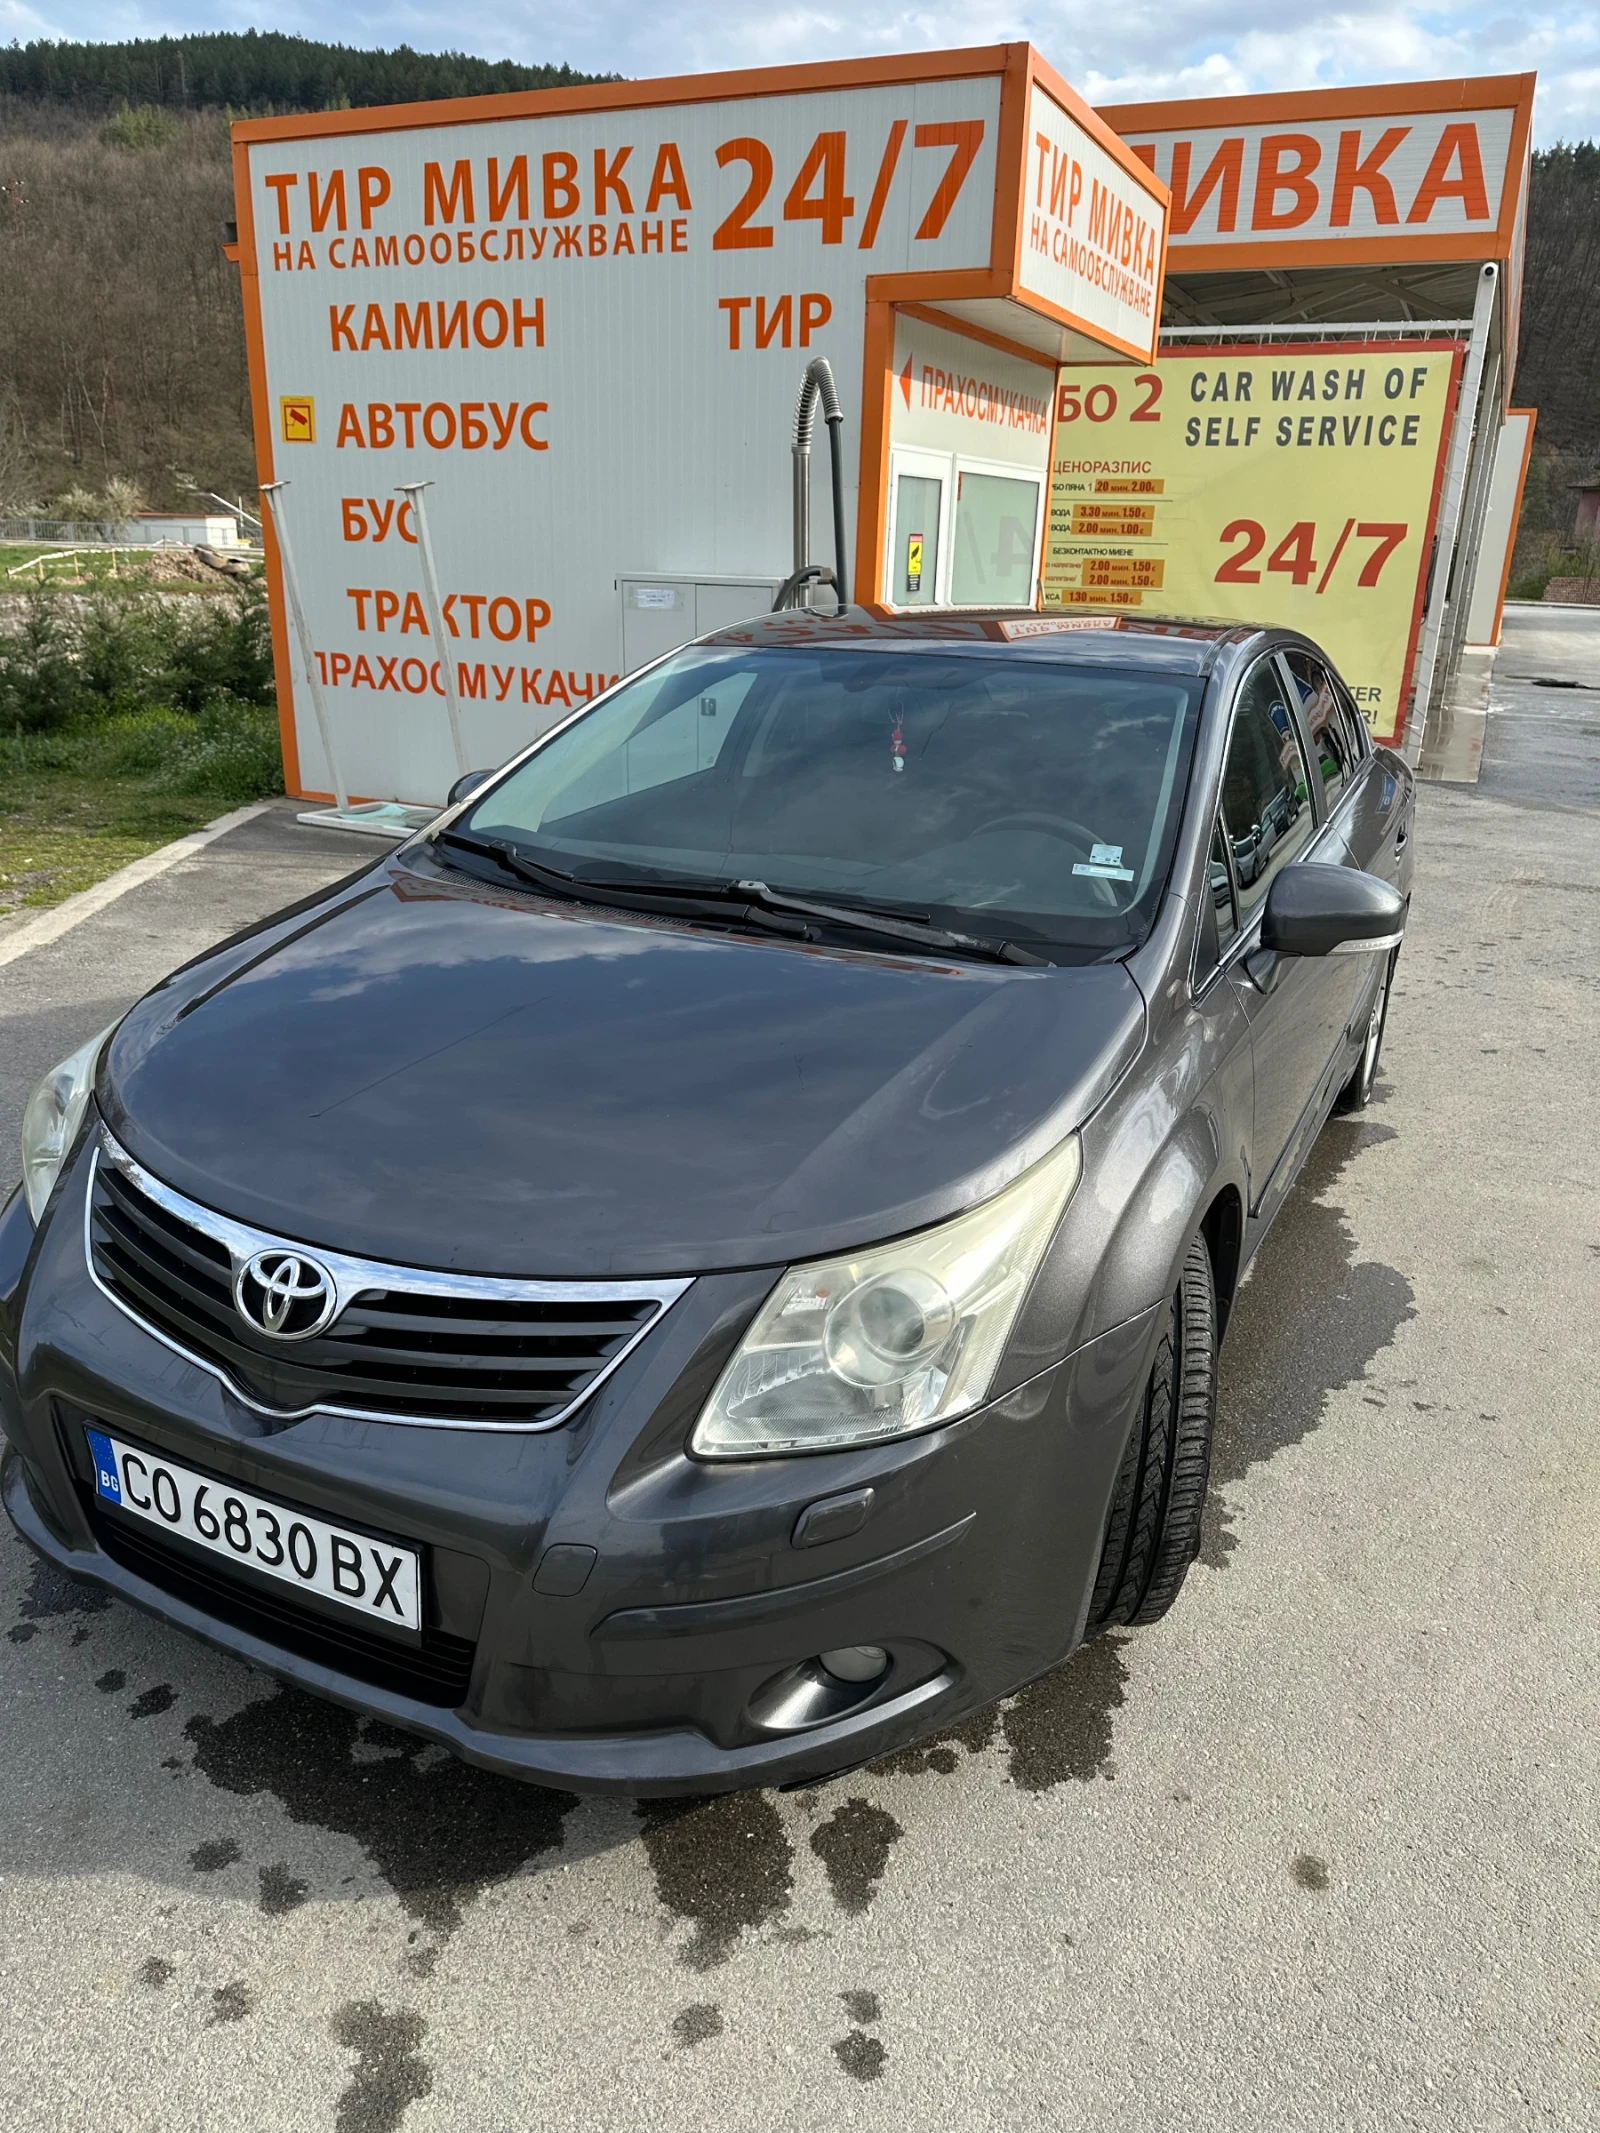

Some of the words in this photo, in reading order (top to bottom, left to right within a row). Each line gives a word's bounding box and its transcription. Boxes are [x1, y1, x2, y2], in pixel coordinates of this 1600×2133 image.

[265, 166, 391, 234] ТИР
[424, 143, 692, 226] МИВКА
[712, 119, 985, 251] 24/7
[1035, 131, 1083, 228] ТИР
[1088, 177, 1156, 287] МИВКА
[273, 240, 316, 271] НА
[328, 218, 689, 269] САМООБСЛУЖВАНЕ
[1030, 212, 1048, 257] НА
[1052, 228, 1152, 318] САМООБСЛУЖВАНЕ
[329, 297, 546, 352] КАМИОН
[719, 293, 832, 350] ТИР
[920, 364, 1048, 435] ПРАХОСМУКАЧКА
[1129, 374, 1163, 422] 2
[1191, 372, 1253, 402] CAR
[1271, 369, 1366, 402] WASH
[1385, 367, 1428, 400] OF
[336, 402, 549, 451] АВТОБУС
[1185, 416, 1261, 447] SELF
[1276, 415, 1421, 447] SERVICE
[341, 498, 419, 544] БУС
[1078, 522, 1099, 533] 2.00
[1080, 506, 1101, 517] 3.30
[1052, 547, 1108, 556] БЕЗКОНТАКТНО
[1090, 560, 1111, 571] 2.00
[1214, 518, 1408, 594] 24/7
[1089, 574, 1109, 585] 2.00
[346, 588, 552, 643] ТРАКТОР
[101, 1470, 119, 1493] BG
[193, 1485, 318, 1580] 6830
